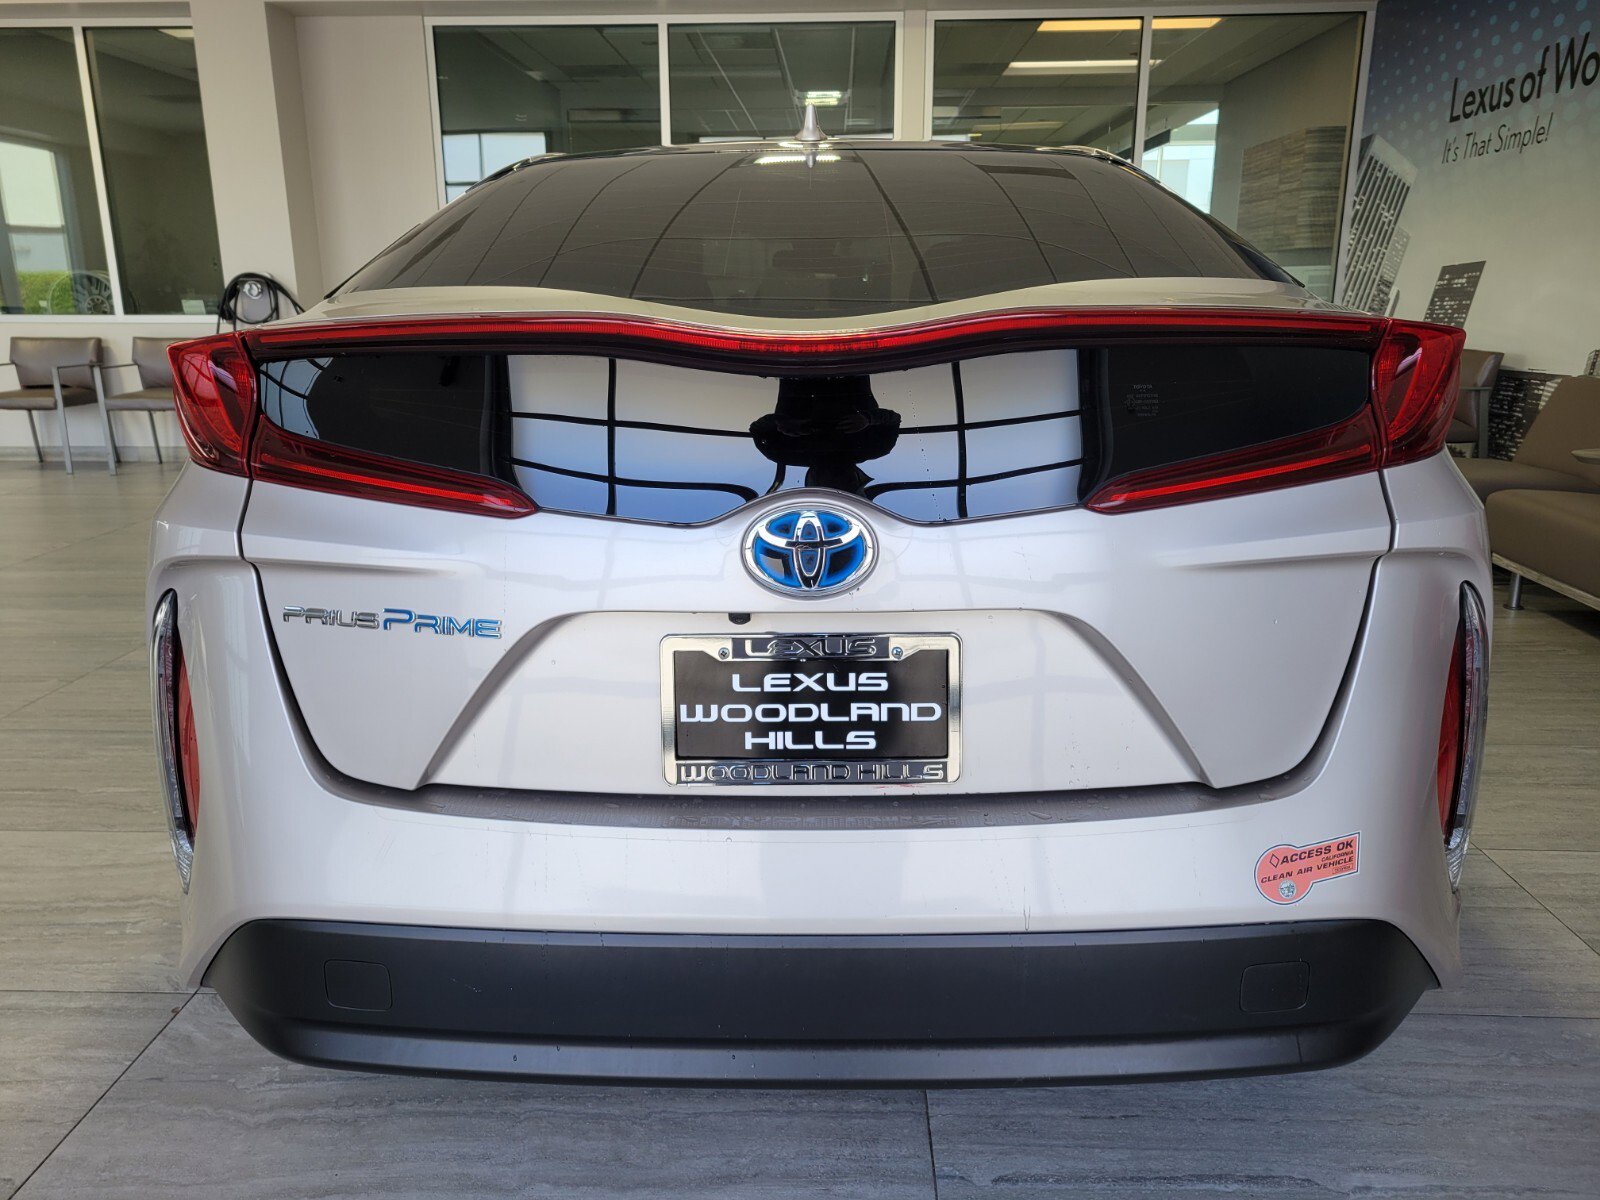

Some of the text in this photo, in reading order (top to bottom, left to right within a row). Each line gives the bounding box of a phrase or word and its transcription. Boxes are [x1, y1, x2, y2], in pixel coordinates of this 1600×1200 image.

[1449, 31, 1600, 123] Lexus of Wo
[1441, 112, 1554, 164] It's That Simple!
[282, 605, 502, 640] PRIUS PRIME
[744, 636, 877, 657] LEXUS
[731, 672, 888, 692] LEXUS
[679, 702, 942, 723] WOODLAND
[744, 731, 877, 750] HILLS
[680, 763, 944, 782] WOODLAND HILLS
[1280, 840, 1353, 865] ACCESS OK
[1321, 850, 1353, 862] CALIFORNIA
[1260, 871, 1293, 884] CLEAN
[1296, 866, 1313, 875] AIR
[1317, 856, 1353, 870] VEHICLE
